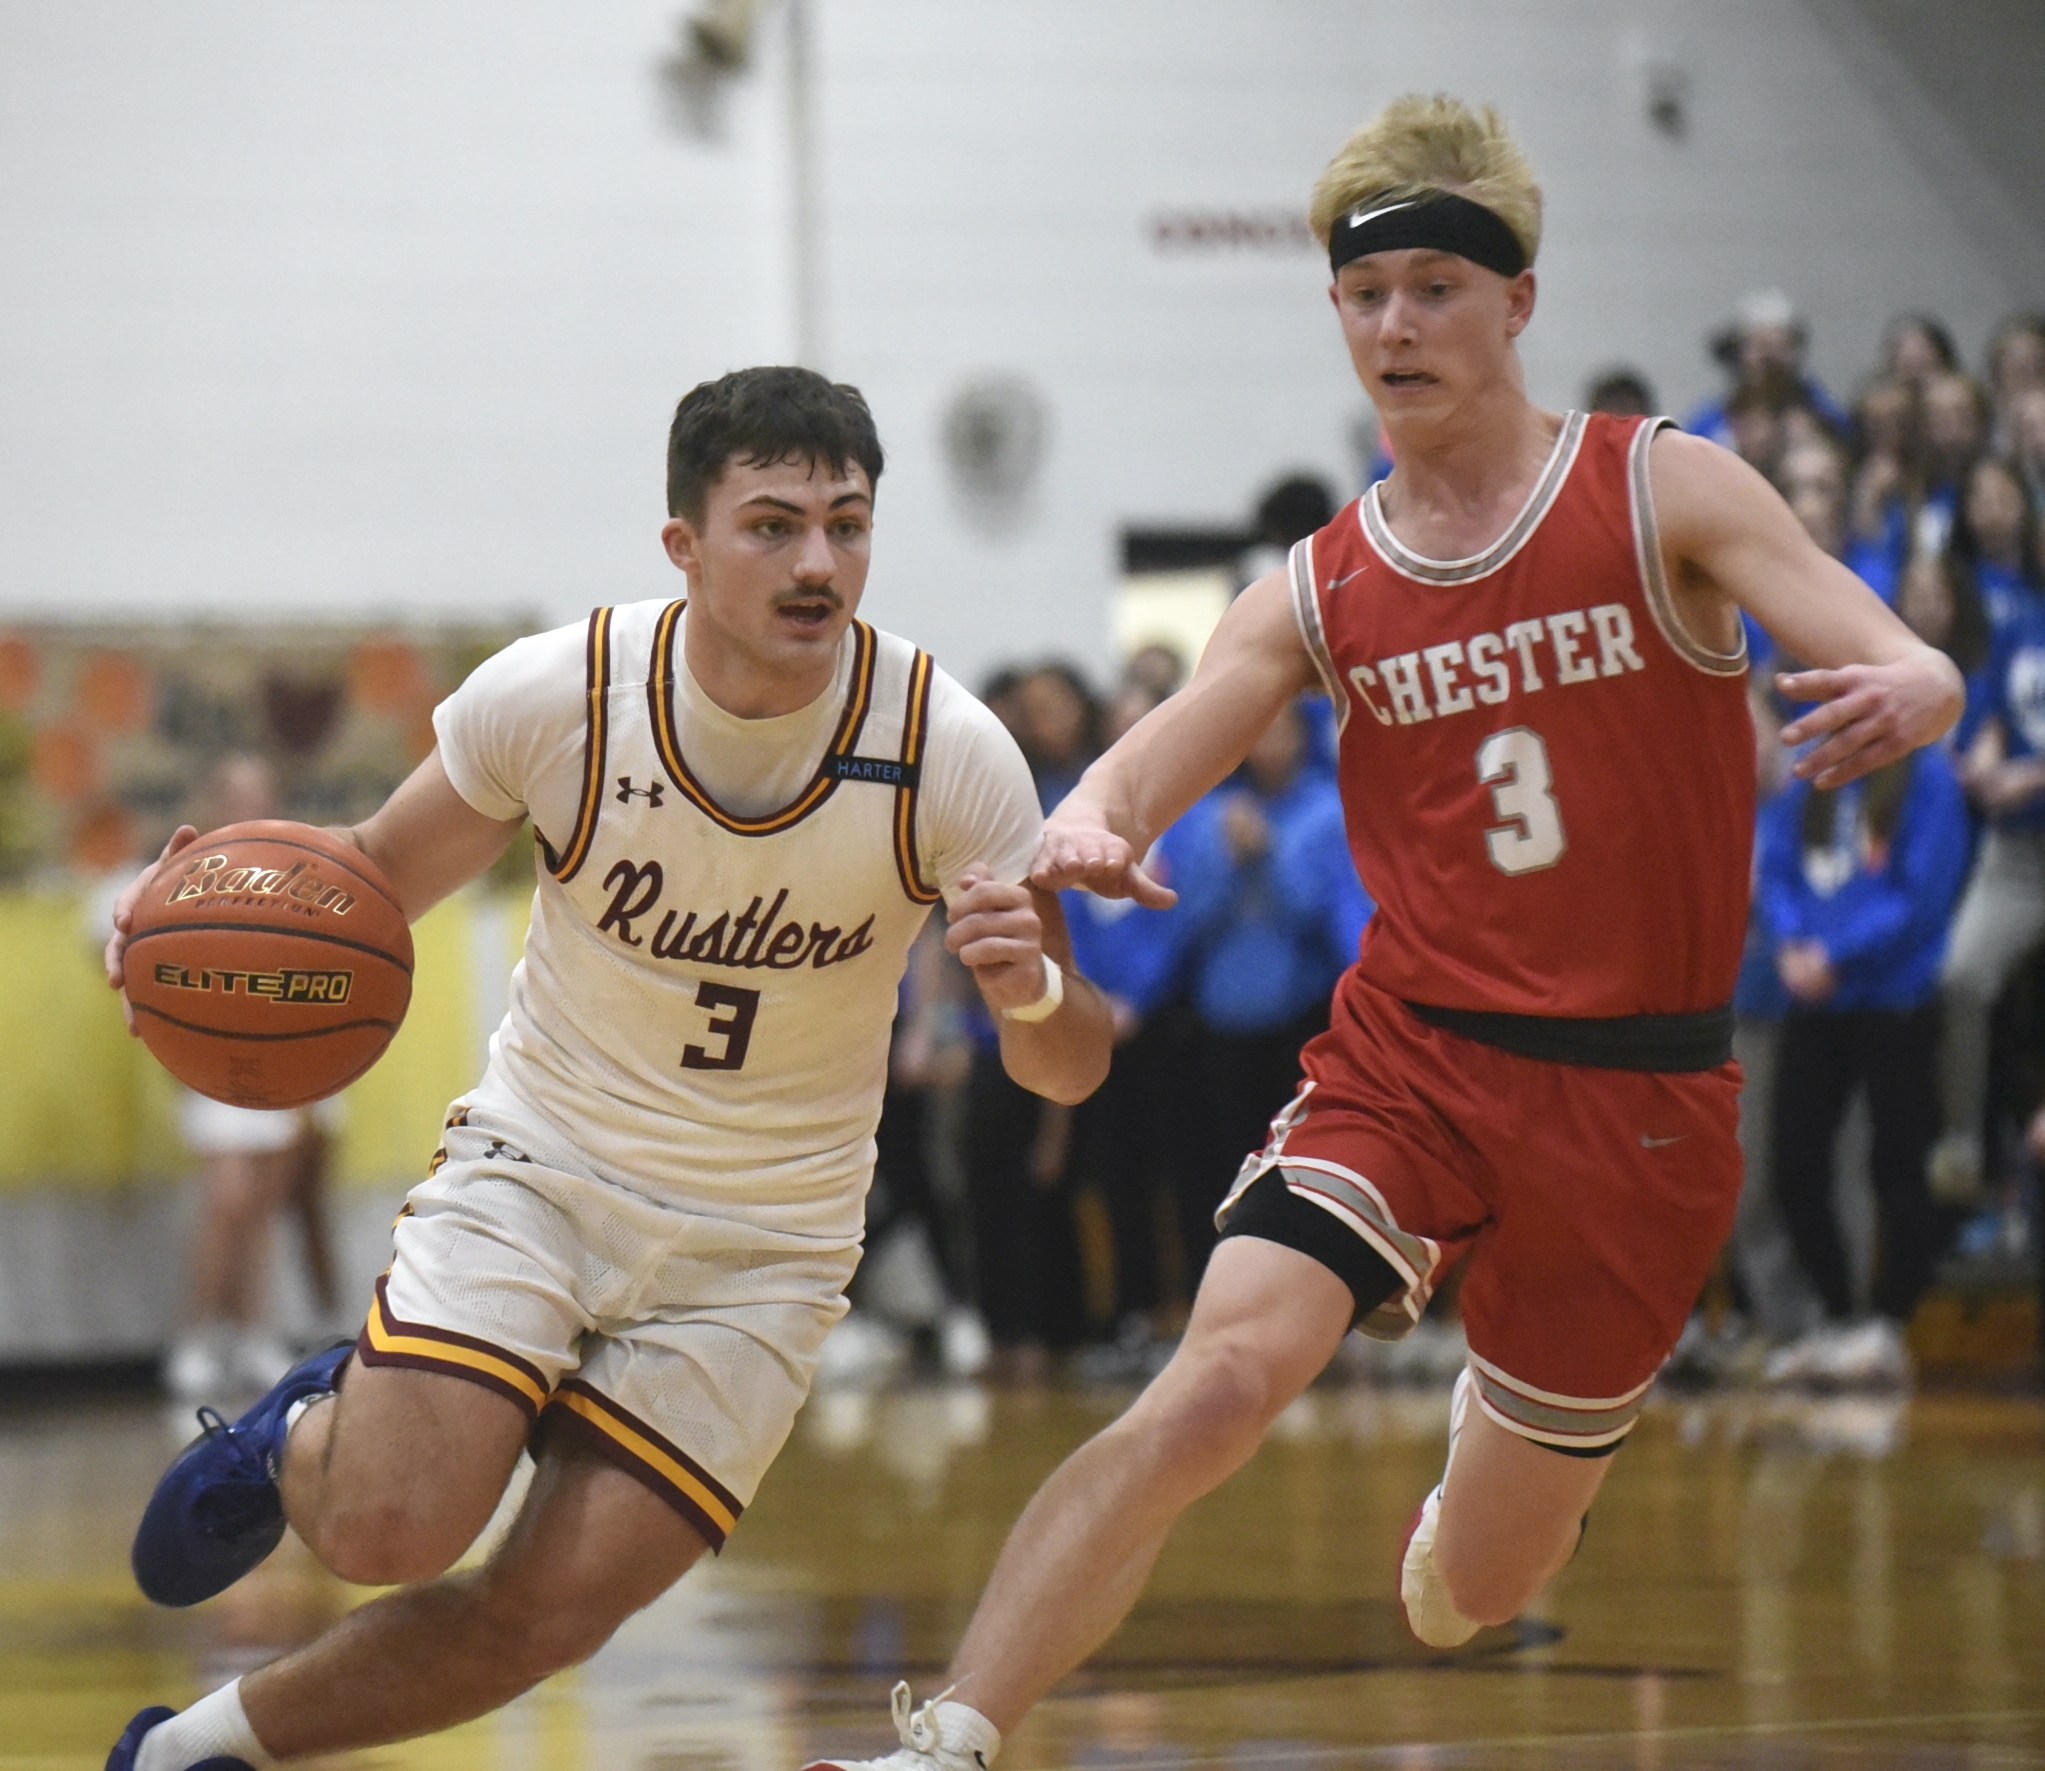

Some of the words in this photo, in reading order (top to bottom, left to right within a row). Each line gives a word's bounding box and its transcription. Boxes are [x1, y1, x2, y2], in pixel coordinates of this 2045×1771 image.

[1349, 603, 1645, 726] CHESTER
[837, 761, 902, 780] HARTER
[1475, 725, 1568, 877] 3
[165, 854, 357, 916] Baden
[597, 859, 875, 969] Rustlers
[680, 981, 760, 1070] 3
